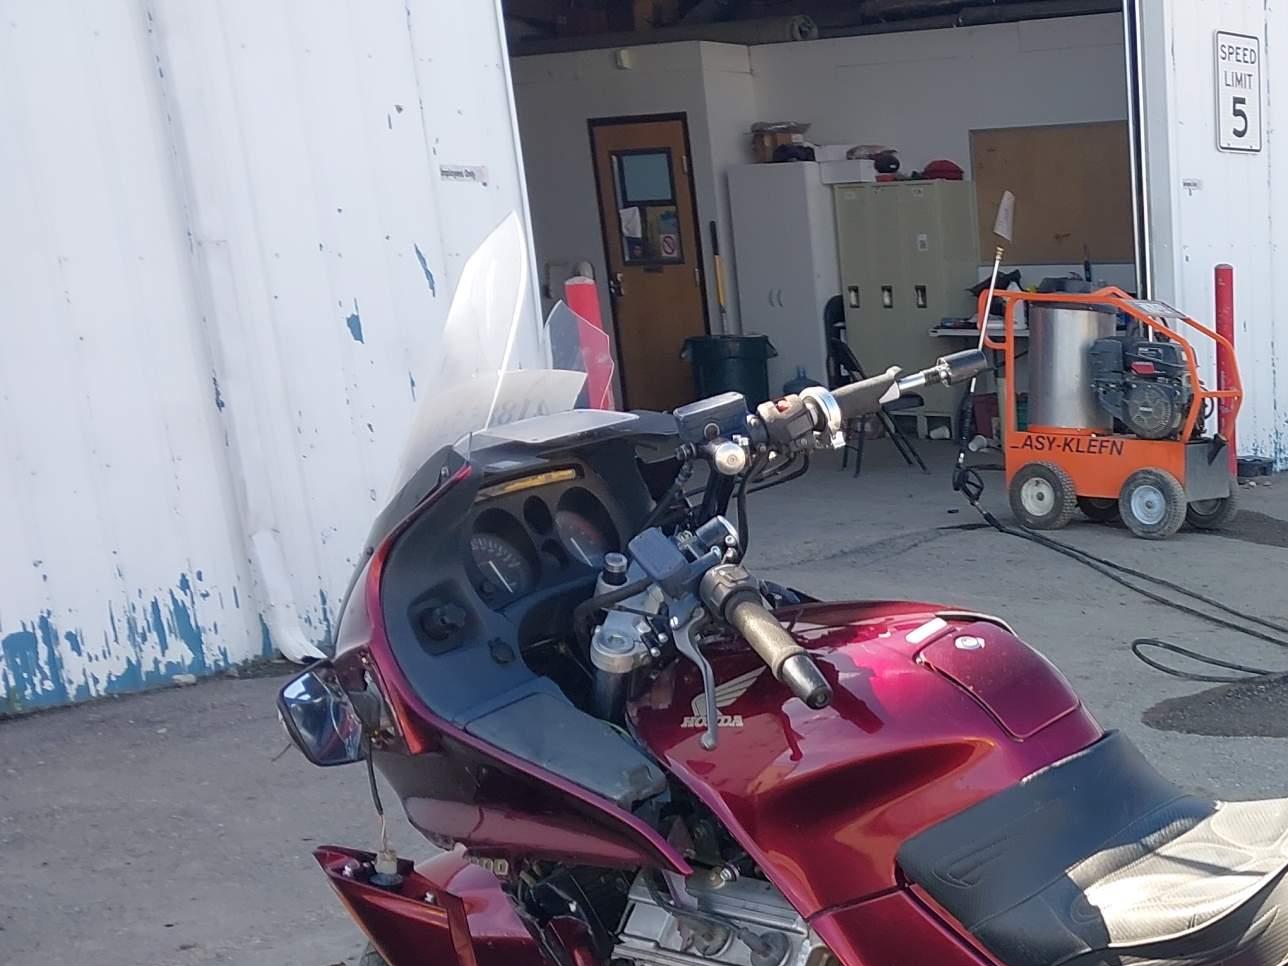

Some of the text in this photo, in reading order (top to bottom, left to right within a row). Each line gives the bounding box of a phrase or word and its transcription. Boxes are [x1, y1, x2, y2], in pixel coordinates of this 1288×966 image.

[1219, 44, 1257, 65] SPEED
[1223, 70, 1254, 90] LIMIT
[1231, 95, 1249, 139] 5
[680, 714, 744, 729] HODA
